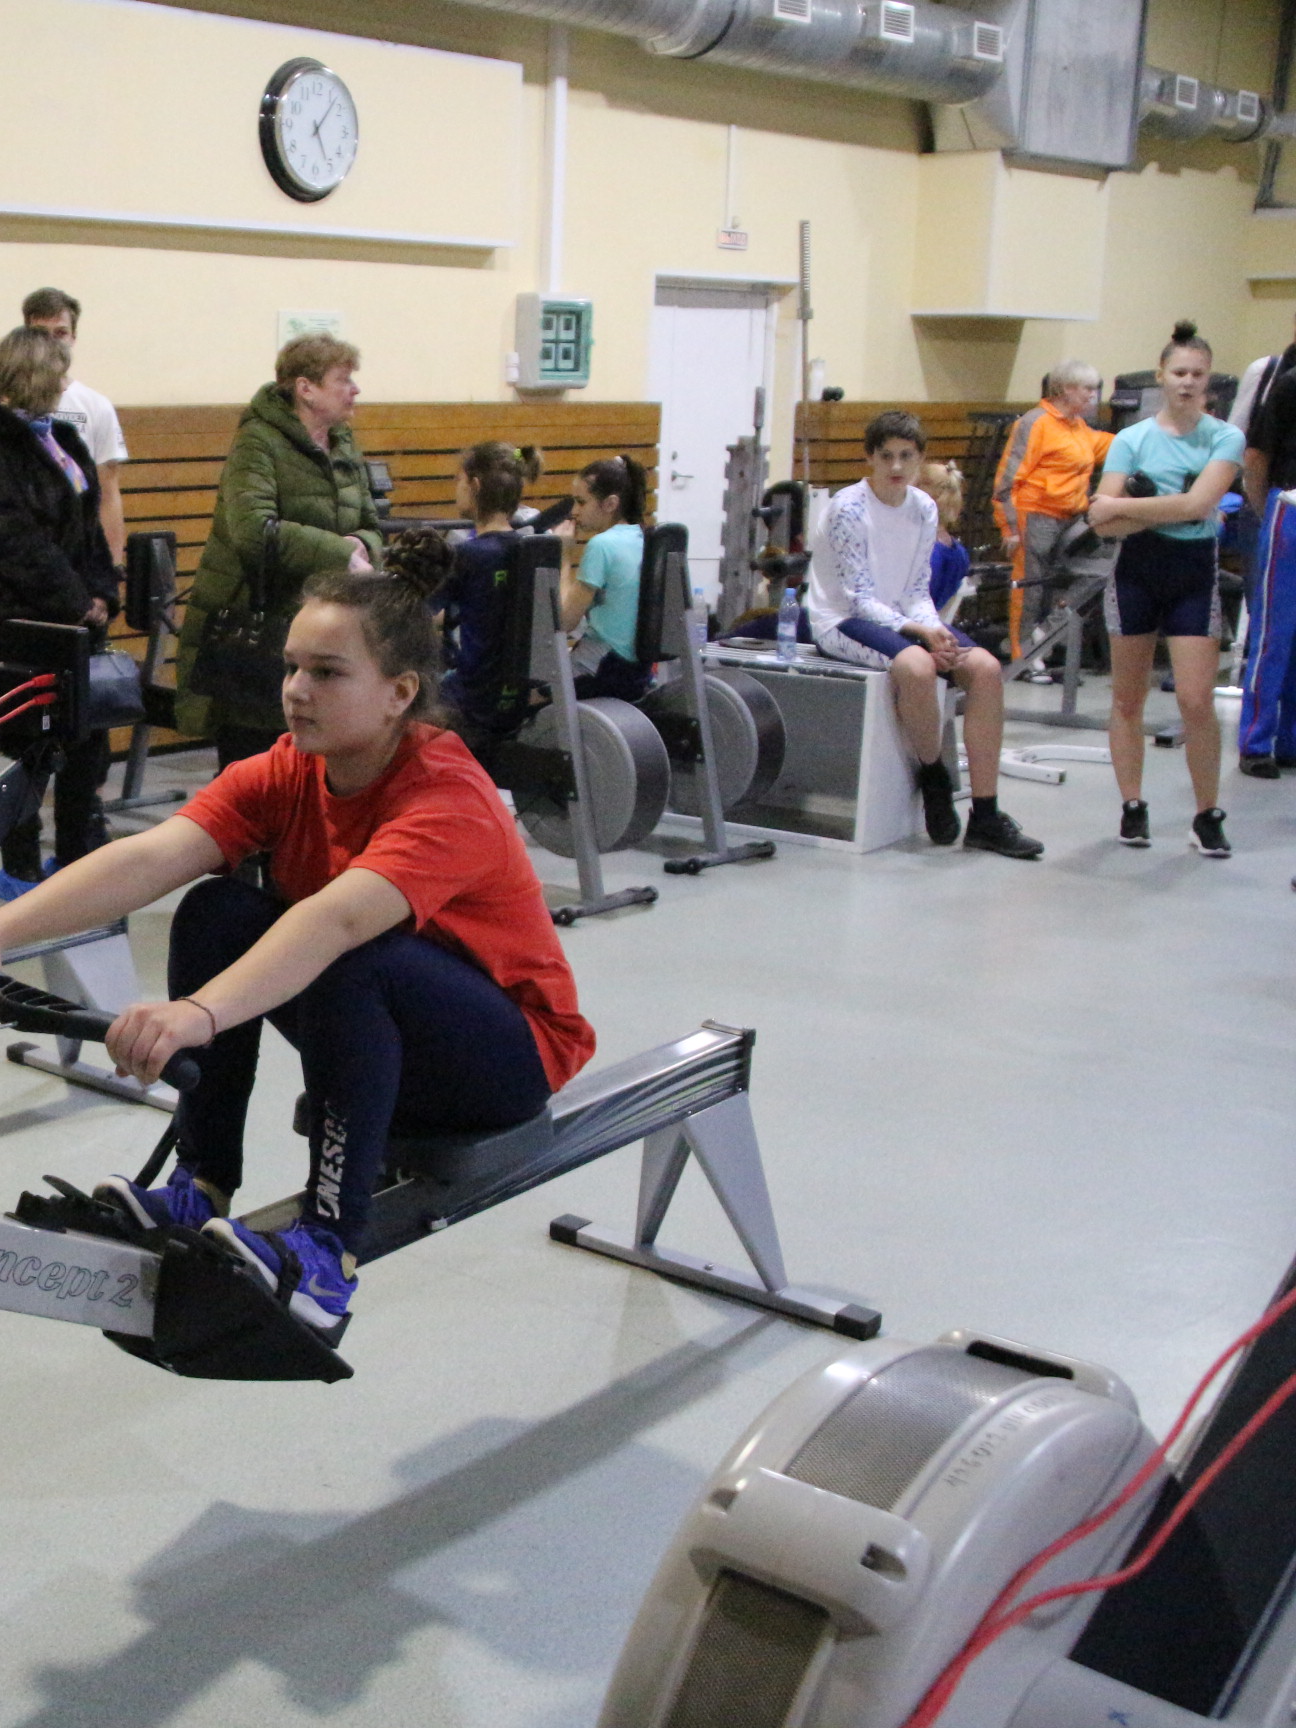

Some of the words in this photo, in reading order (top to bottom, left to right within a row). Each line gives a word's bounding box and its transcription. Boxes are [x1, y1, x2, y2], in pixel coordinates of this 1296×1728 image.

[300, 86, 310, 100] 11
[312, 81, 323, 96] 12
[291, 101, 302, 115] 10
